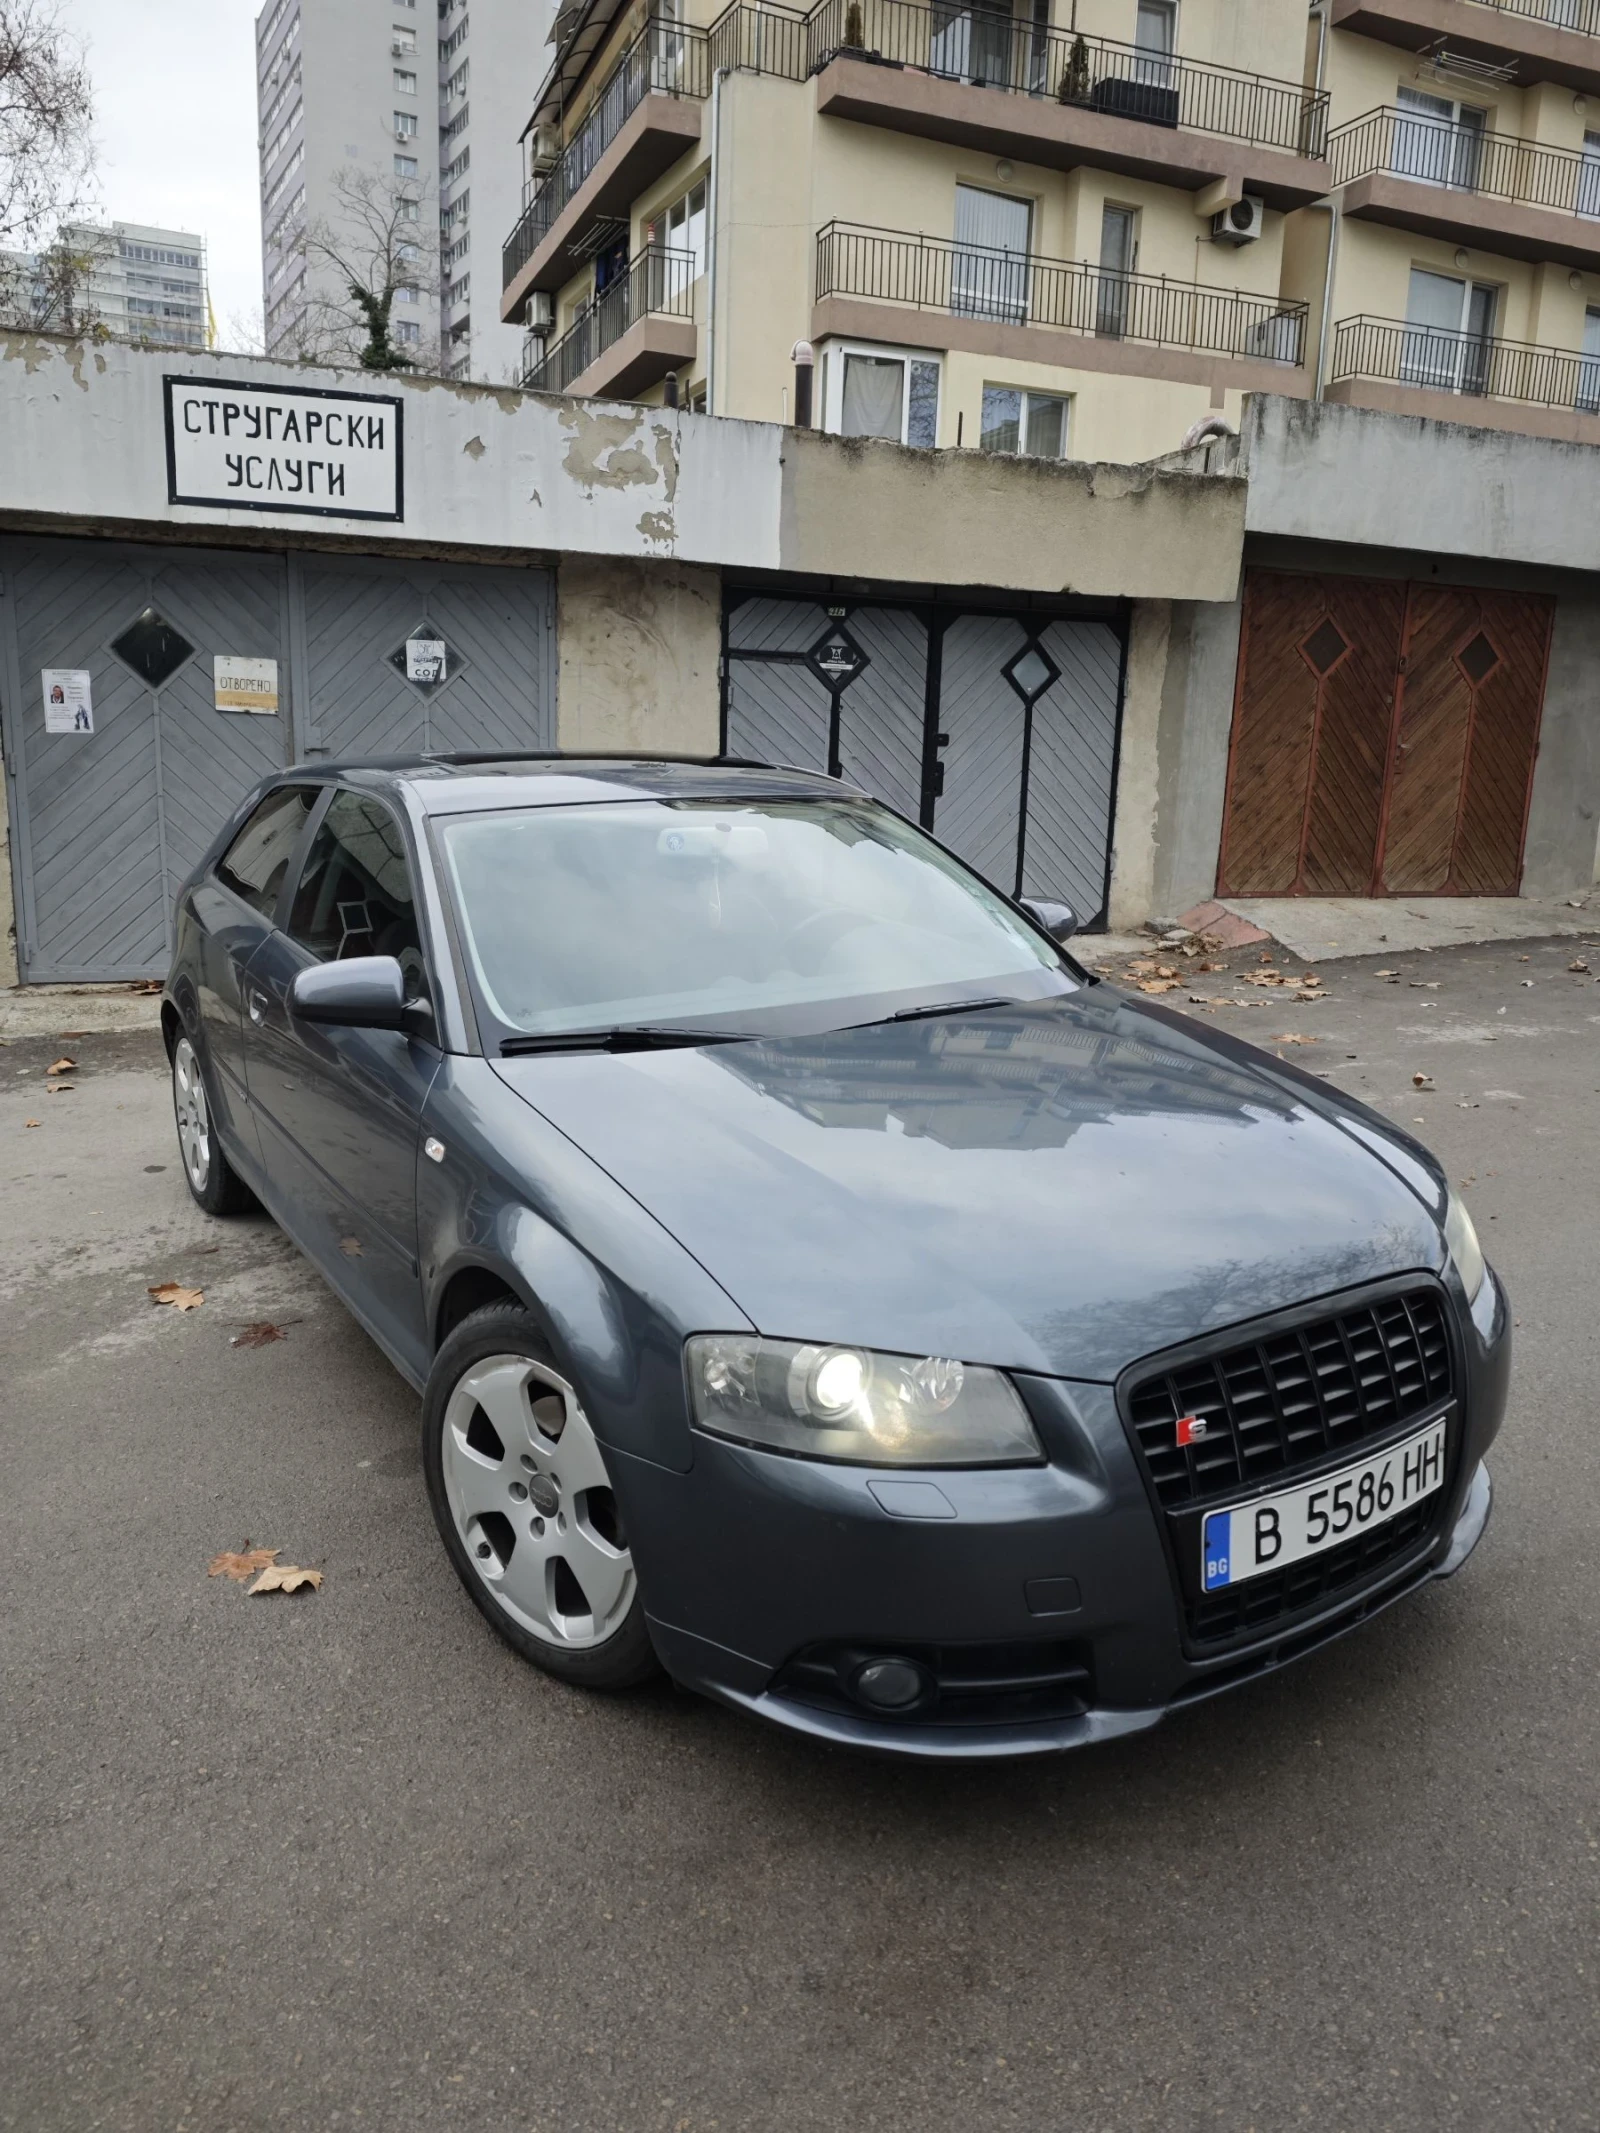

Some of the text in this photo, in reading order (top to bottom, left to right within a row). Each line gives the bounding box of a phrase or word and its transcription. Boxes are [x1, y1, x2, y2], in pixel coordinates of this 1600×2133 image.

[184, 399, 384, 450] СТРУГАРСКИ
[225, 453, 345, 496] УСЛУГИ
[220, 676, 271, 693] ОТВОРЕНО
[1255, 1433, 1441, 1565] B 5586 HH
[1207, 1557, 1228, 1579] BG
